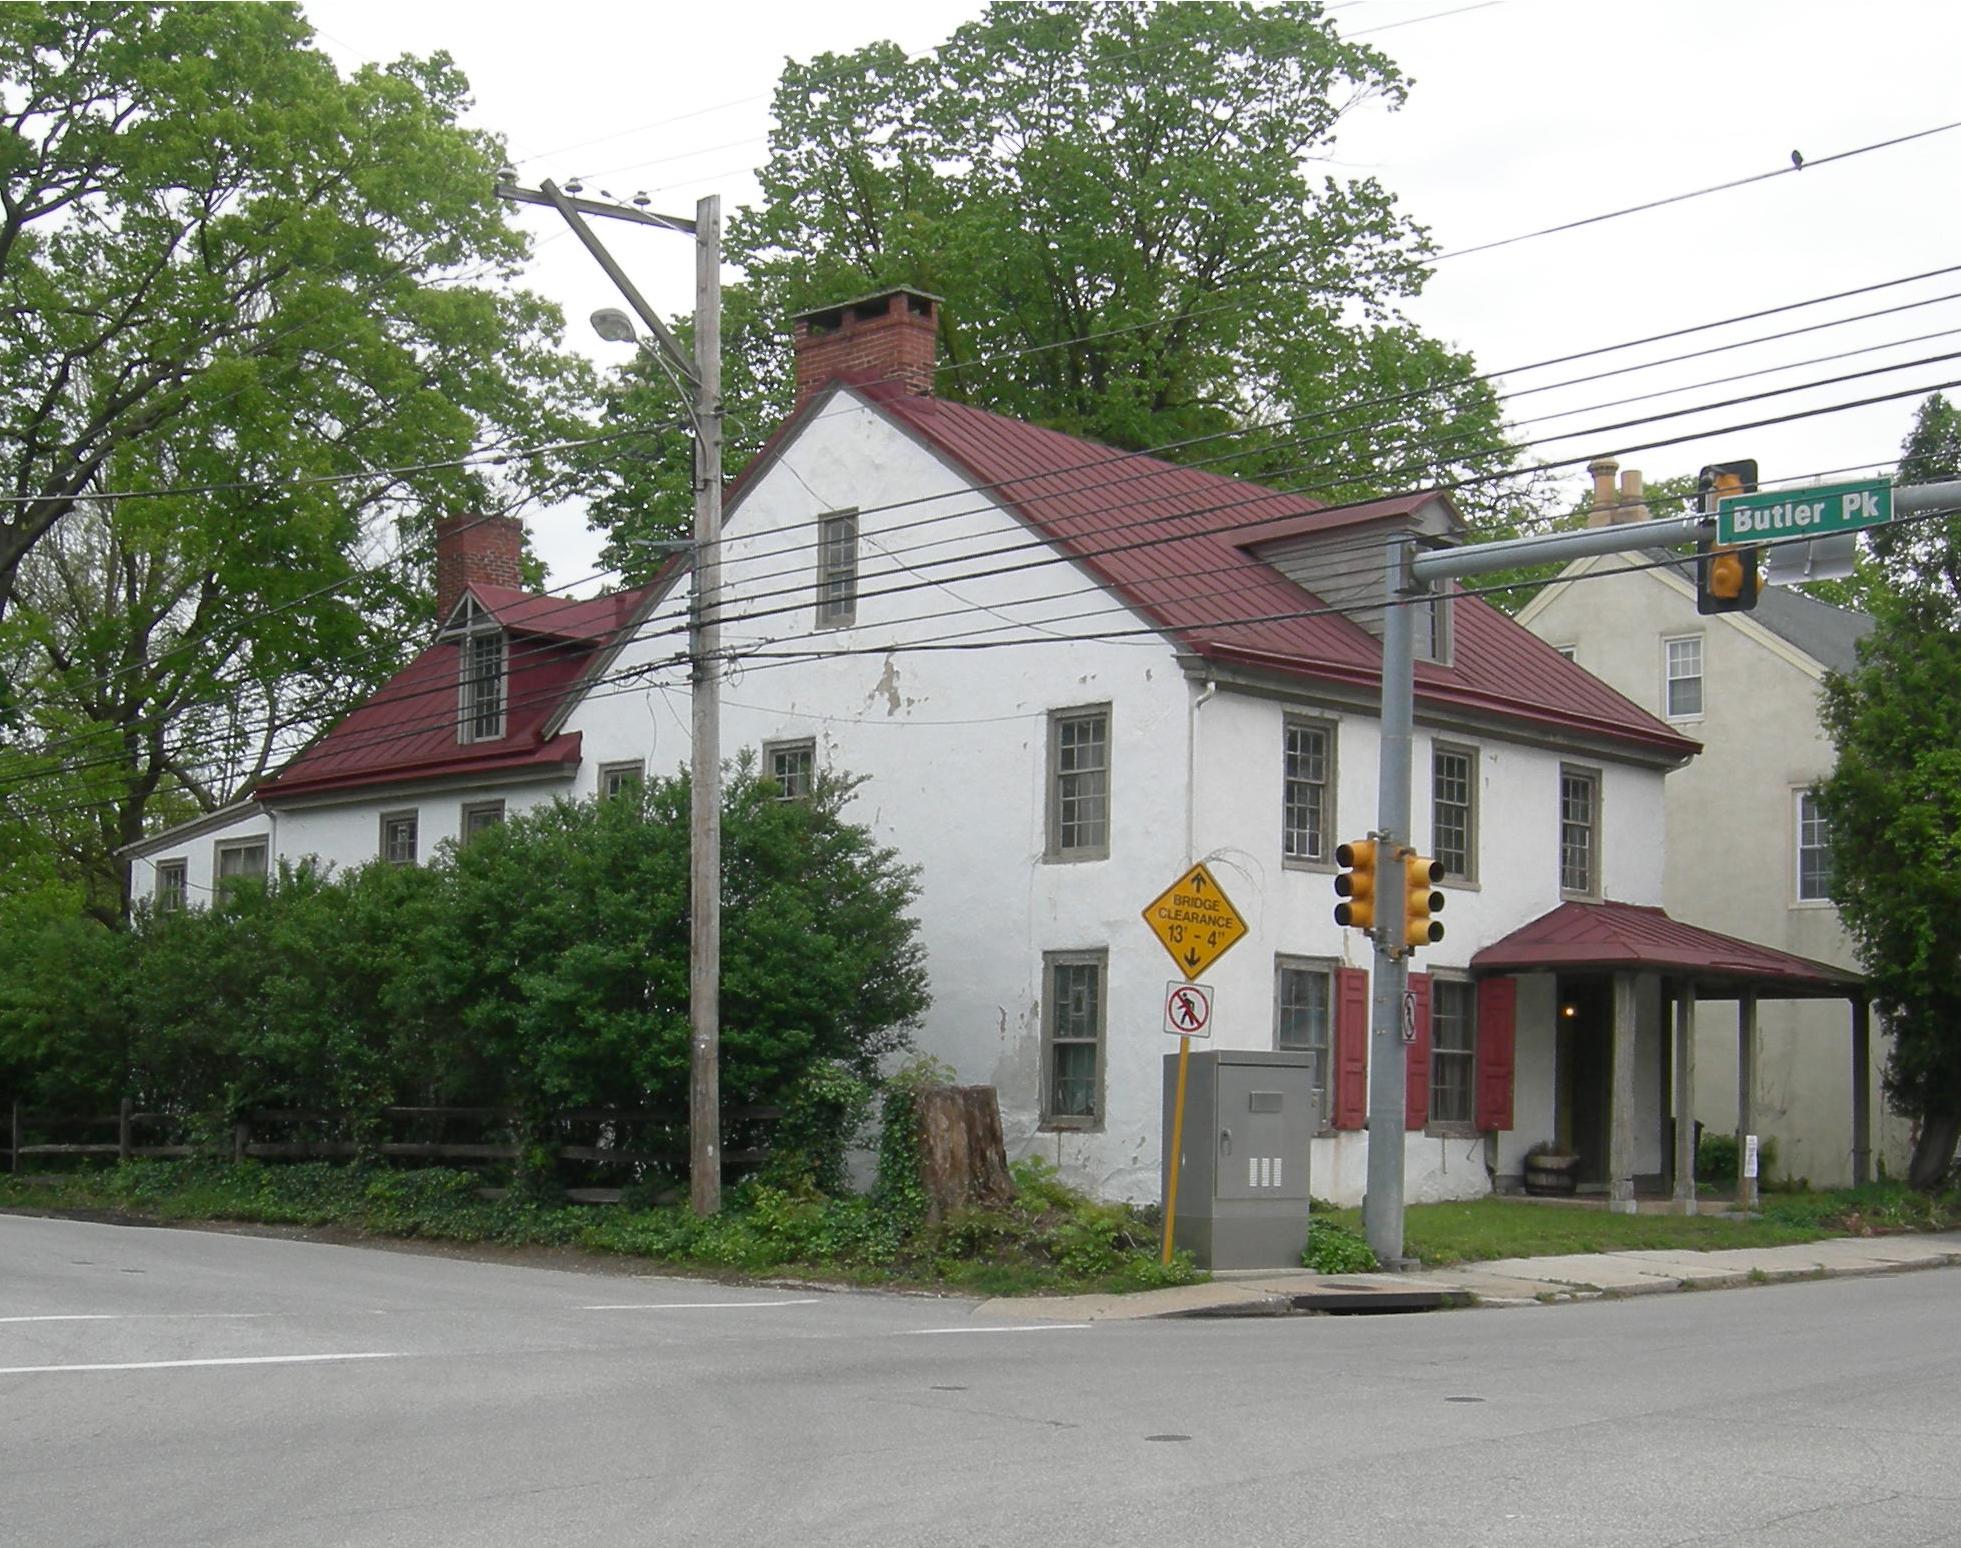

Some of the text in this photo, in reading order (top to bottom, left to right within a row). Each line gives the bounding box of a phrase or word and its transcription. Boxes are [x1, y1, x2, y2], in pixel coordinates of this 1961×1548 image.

[1733, 491, 1879, 533] Butler Pk
[1173, 894, 1220, 912] BRIDGE
[1158, 907, 1233, 929] CLEARANCE
